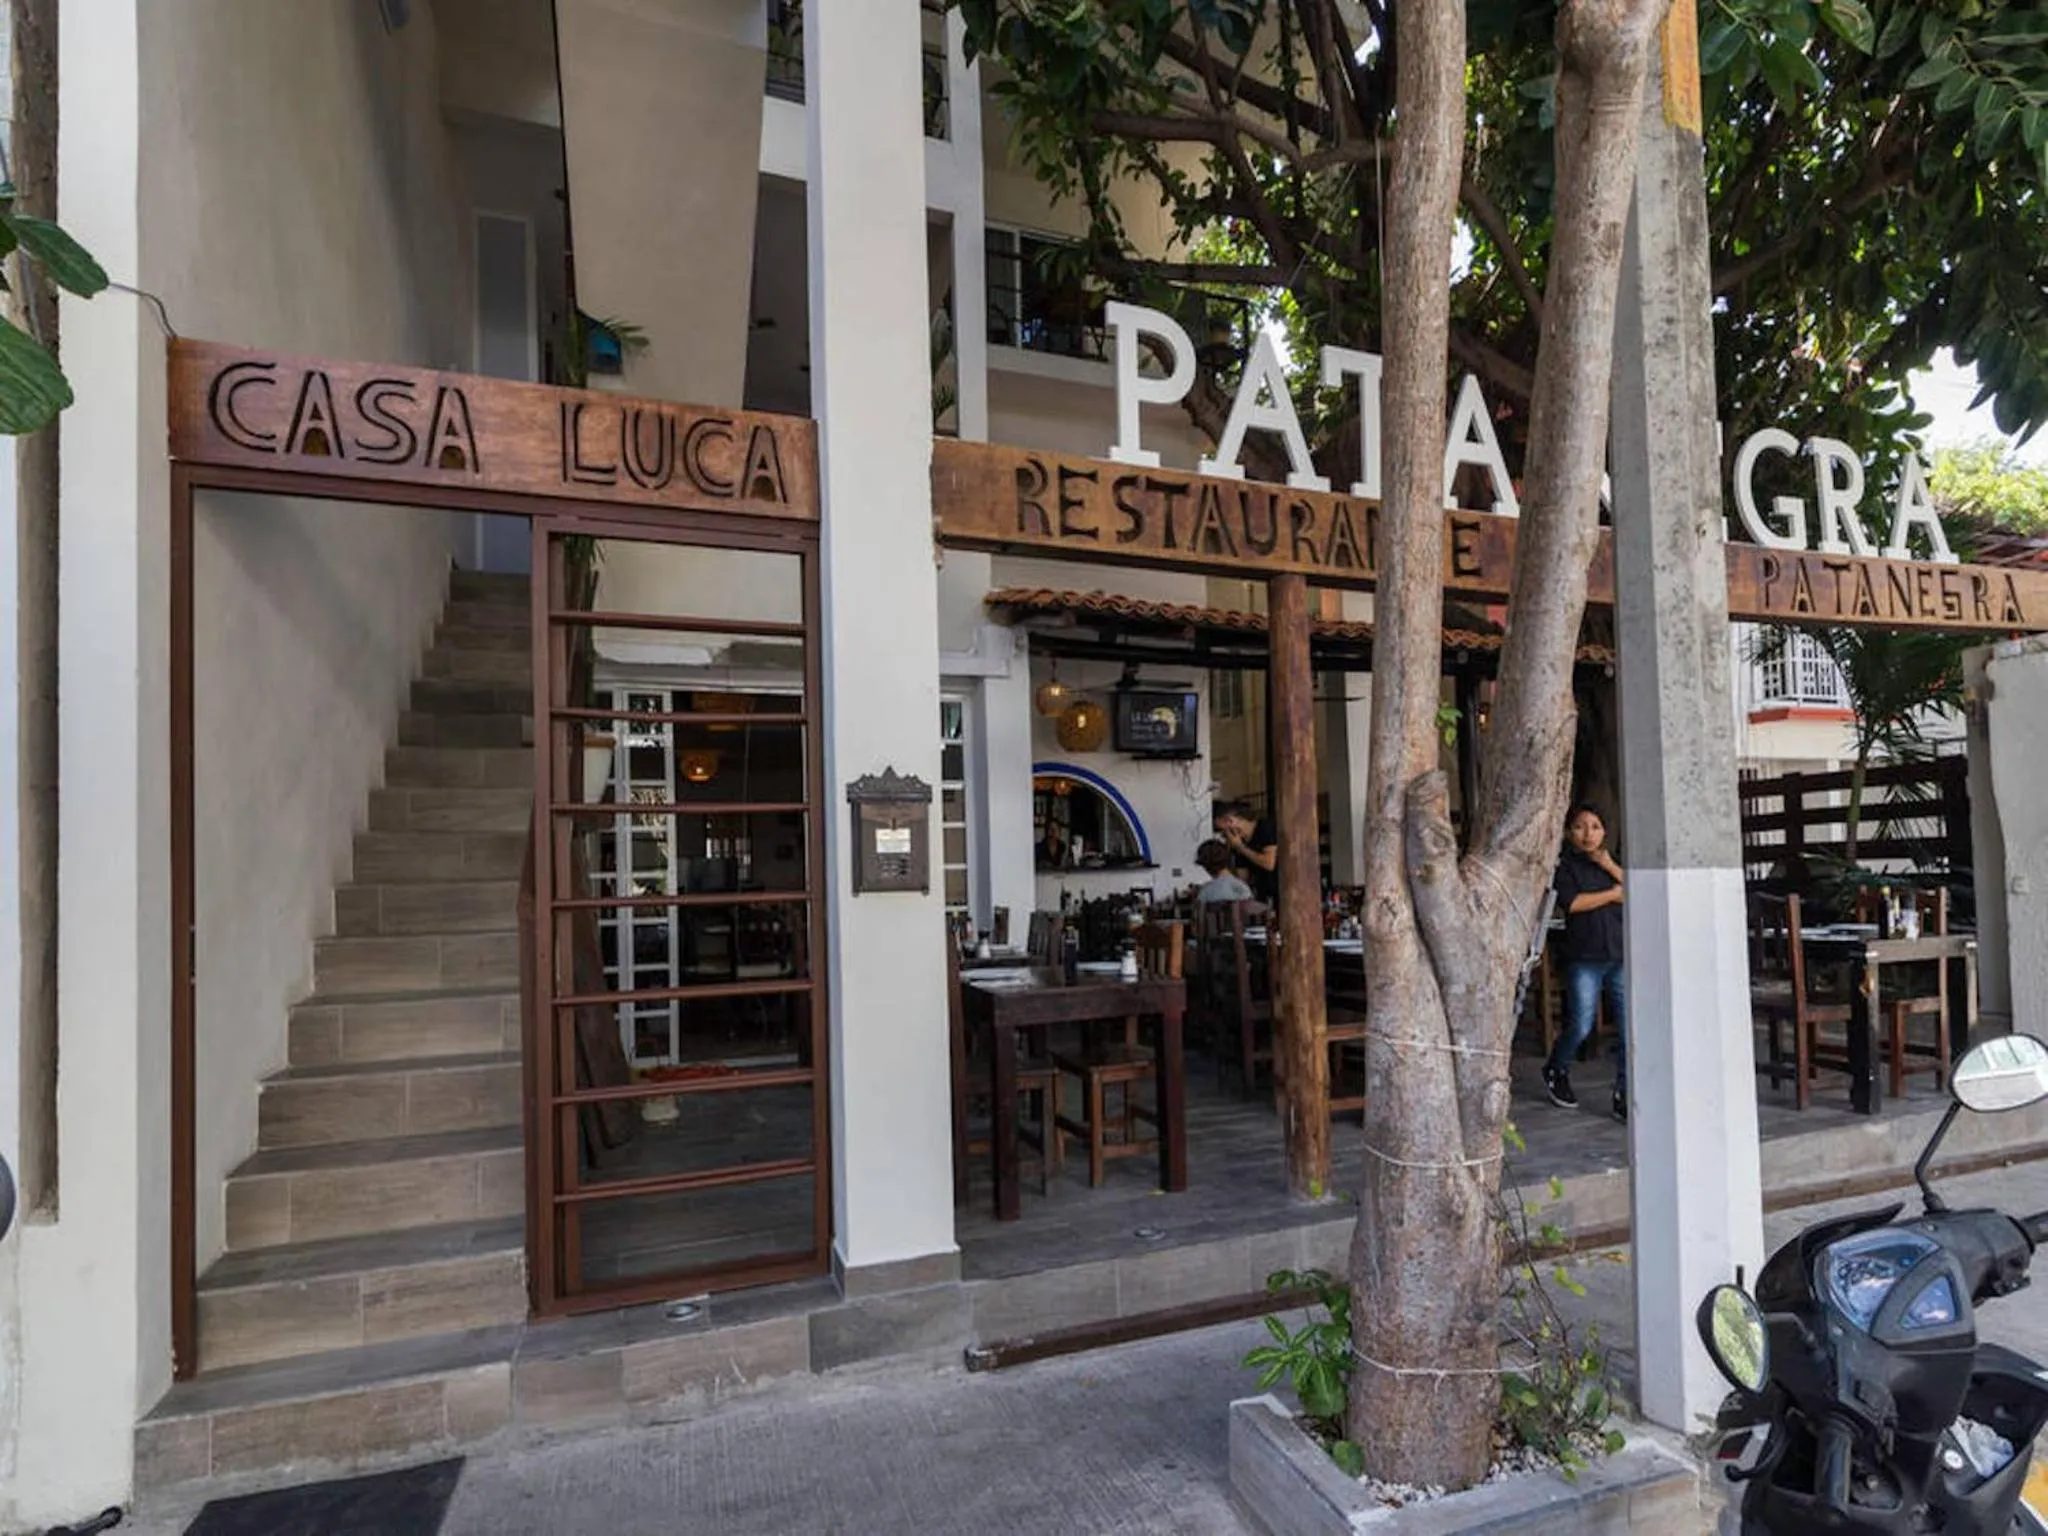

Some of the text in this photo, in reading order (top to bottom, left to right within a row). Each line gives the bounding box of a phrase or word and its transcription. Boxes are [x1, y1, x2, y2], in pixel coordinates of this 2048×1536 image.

[207, 361, 788, 503] CASA LUCA
[1104, 299, 1960, 564] PATA GRA
[1014, 457, 1482, 579] RESTAURAE
[1761, 555, 2025, 624] PATANEGRA
